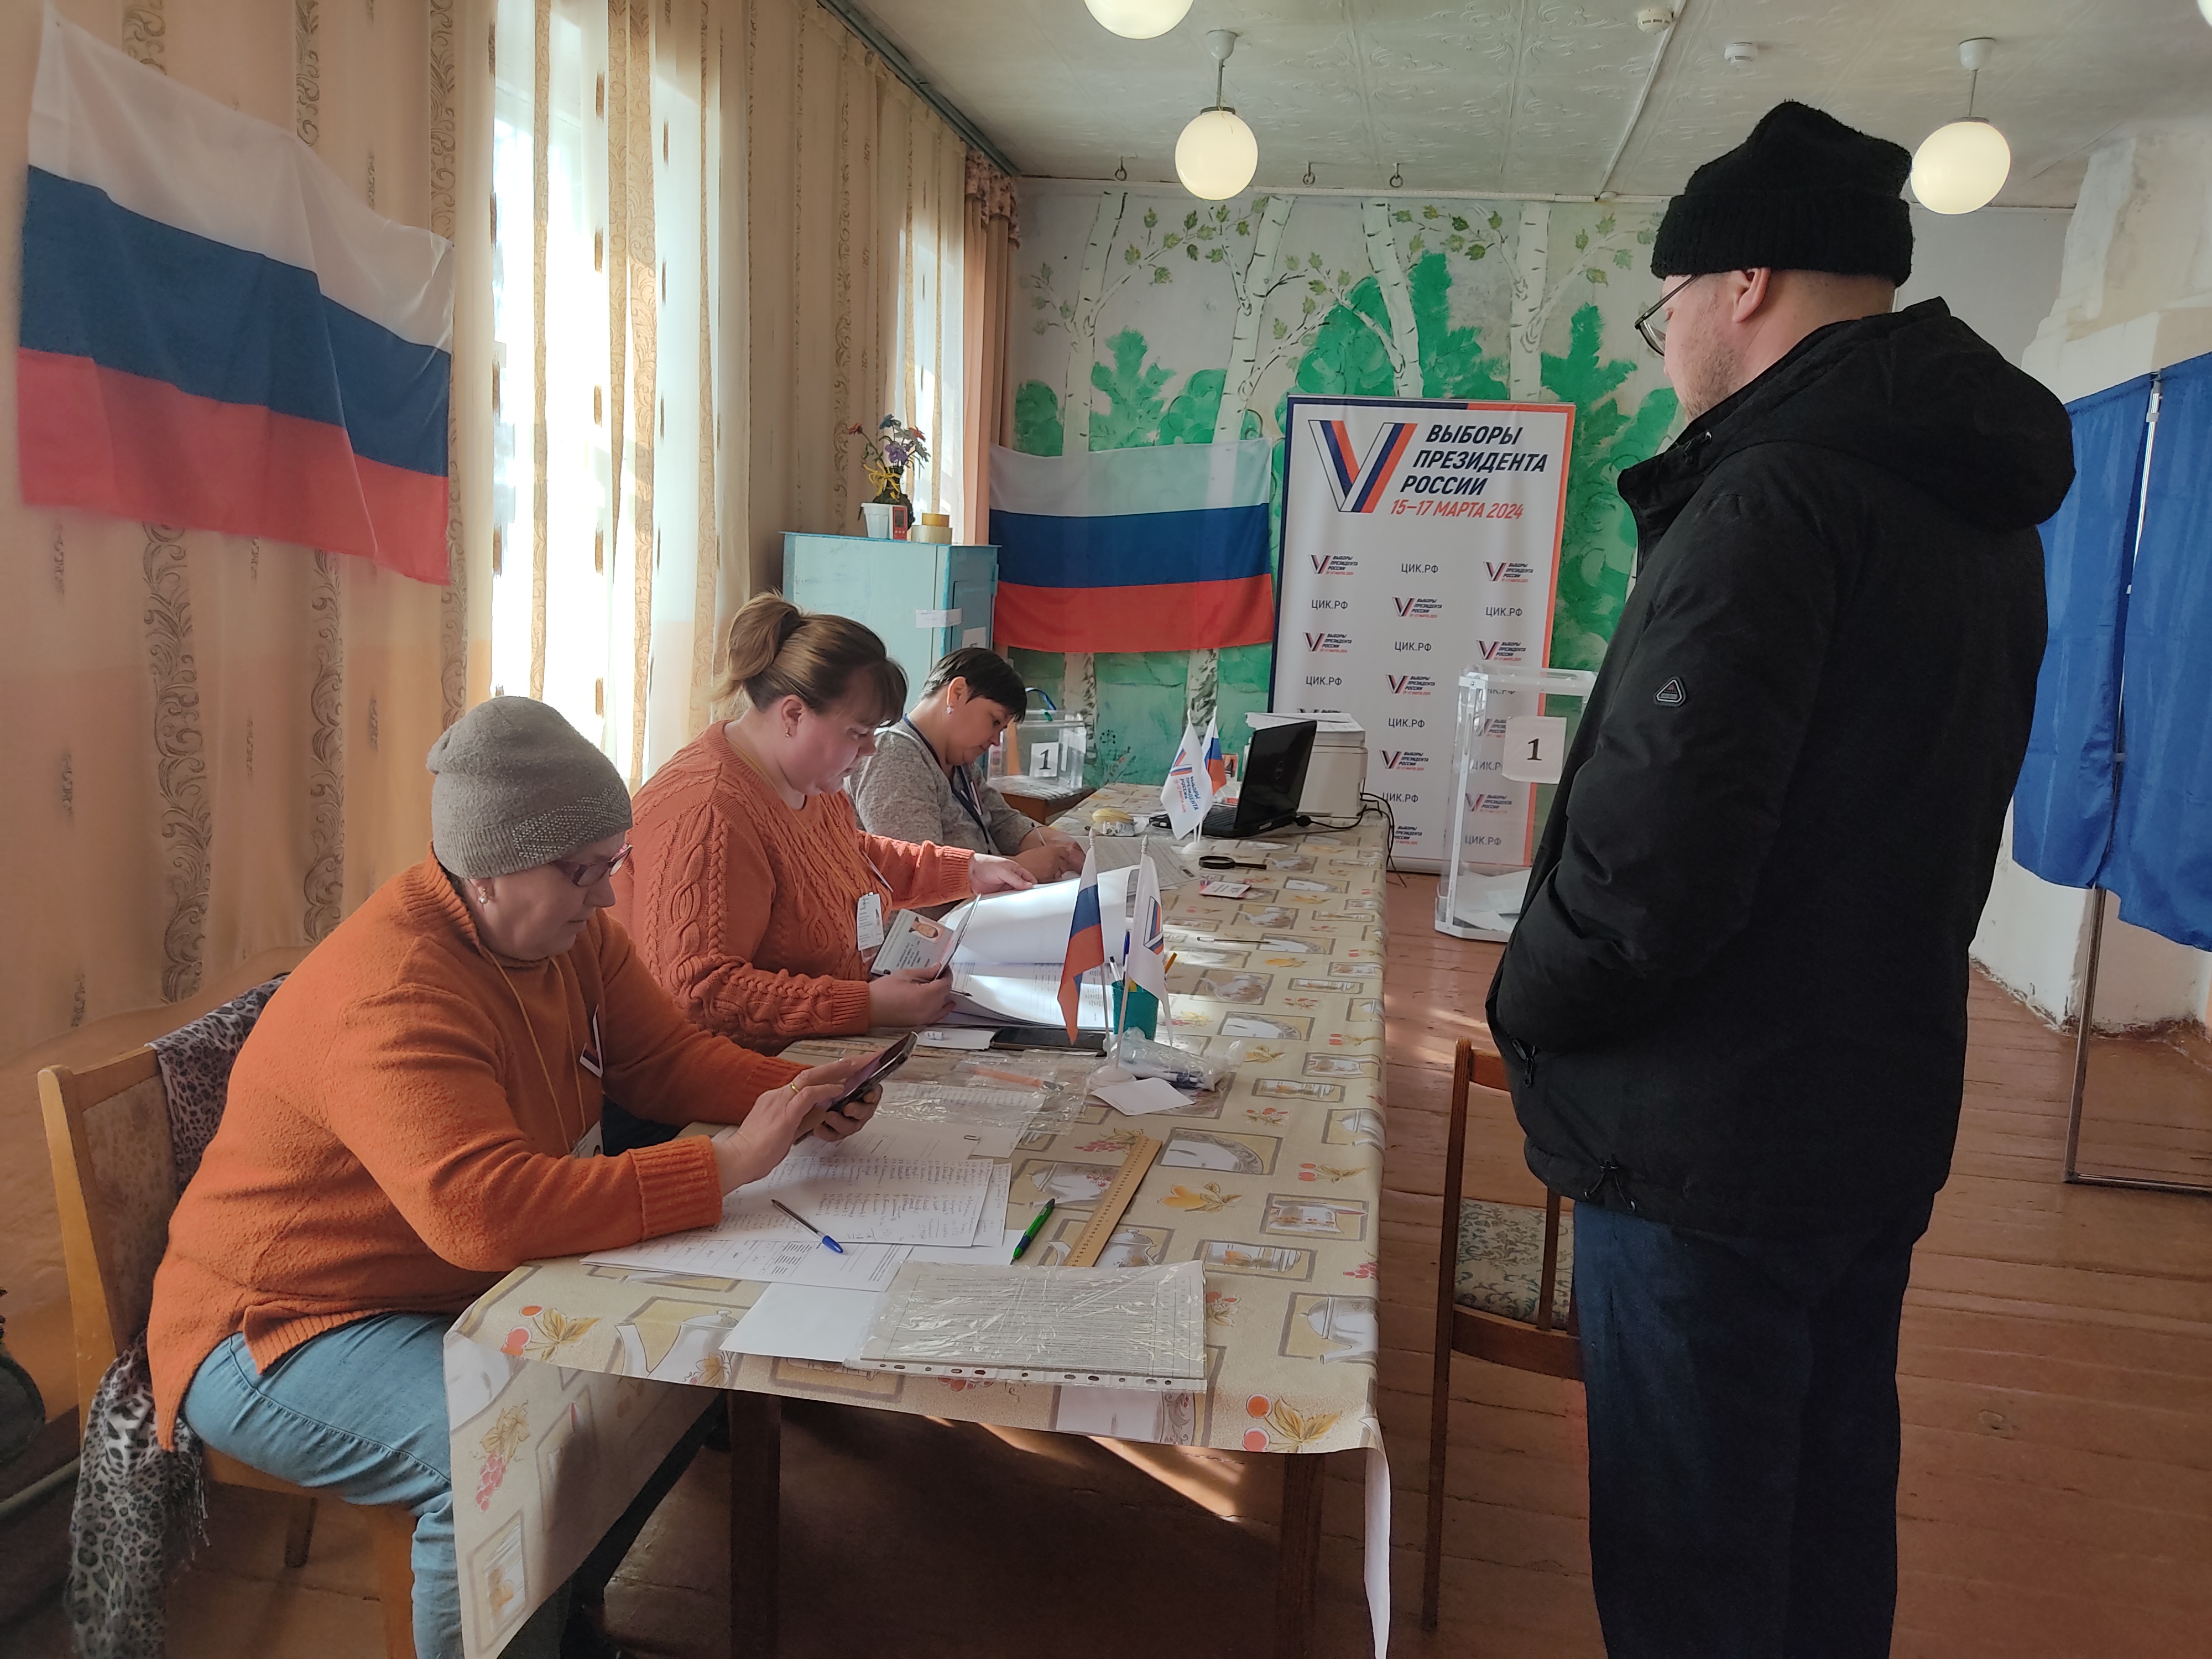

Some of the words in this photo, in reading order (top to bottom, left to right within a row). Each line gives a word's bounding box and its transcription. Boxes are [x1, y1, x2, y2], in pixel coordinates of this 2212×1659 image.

[1425, 424, 1524, 445] ВЫБОРЫ
[1412, 450, 1548, 473] ПРЕЗИДЕНТА
[1400, 475, 1489, 495] РОССИИ
[1433, 500, 1486, 518] МАРТА
[1486, 503, 1524, 519] 2024
[1401, 564, 1439, 575] ЦИК.РФ
[1311, 599, 1348, 611] ЦИК.РФ
[1486, 607, 1523, 618] ЦИК.РФ
[1395, 641, 1432, 653] ЦИК.РФ
[1306, 676, 1343, 687] ЦИК.РФ
[1388, 718, 1425, 729] ЦИК.РФ
[1527, 738, 1542, 761] 1
[1039, 749, 1051, 770] 1
[1383, 792, 1418, 803] ЦИК.РФ
[1465, 834, 1502, 846] ЦИК.РФ
